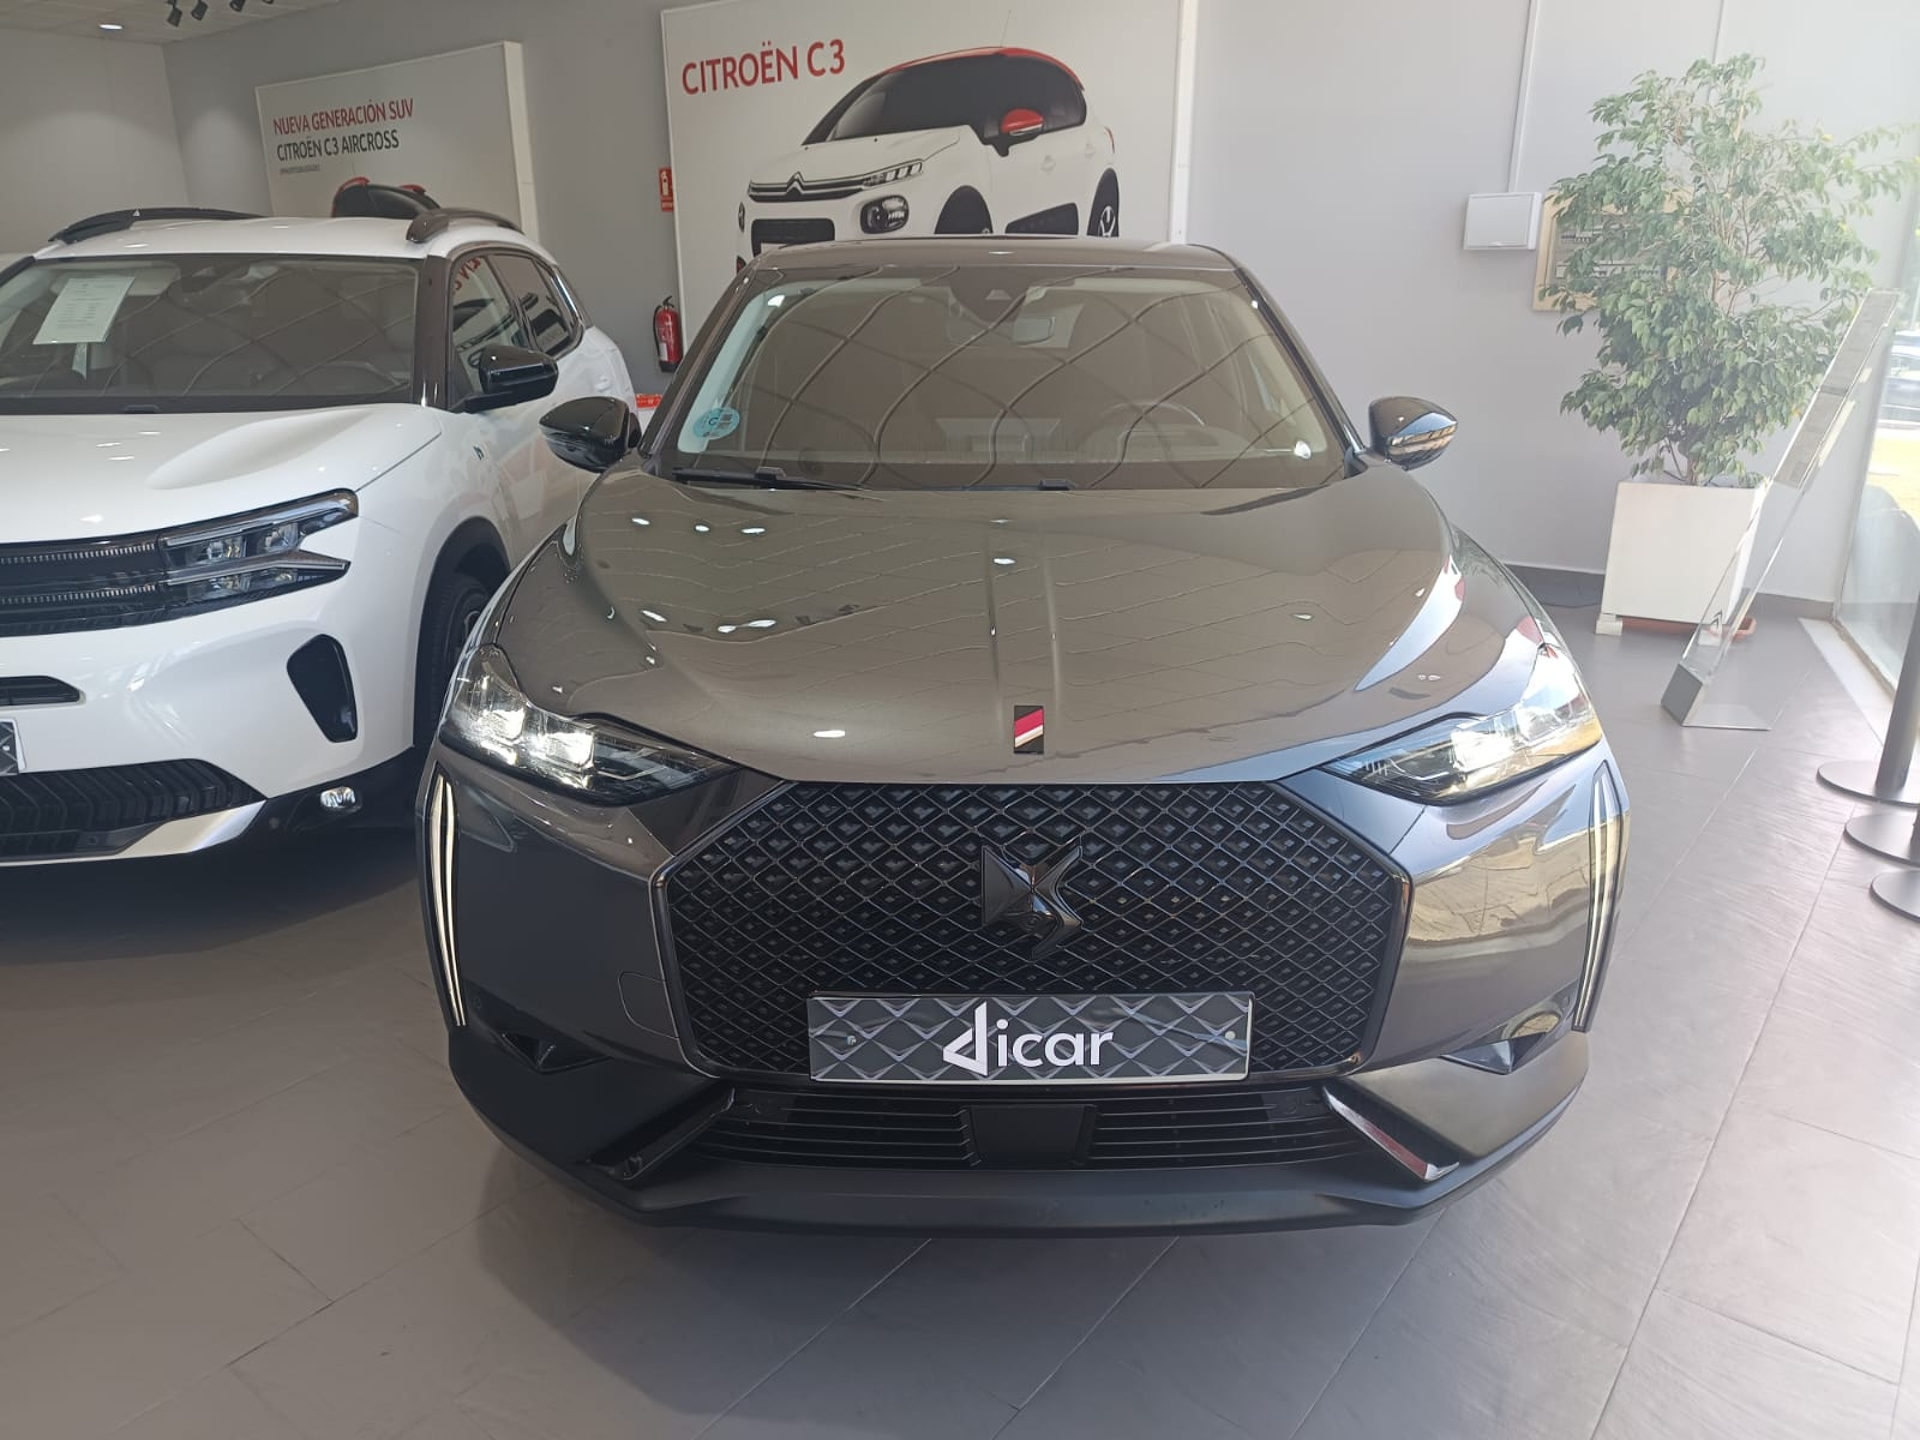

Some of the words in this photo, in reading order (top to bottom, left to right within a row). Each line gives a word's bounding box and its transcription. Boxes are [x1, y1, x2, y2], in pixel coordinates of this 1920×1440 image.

[682, 40, 798, 95] CITROËN
[807, 38, 845, 77] C3
[273, 114, 311, 135] NUEVA
[311, 99, 386, 131] GENERACIÓN
[389, 98, 414, 120] SUV
[276, 136, 323, 162] CITROËN
[324, 137, 340, 156] C3
[341, 129, 400, 154] AIRCROSS
[942, 1000, 1115, 1076] dicar
